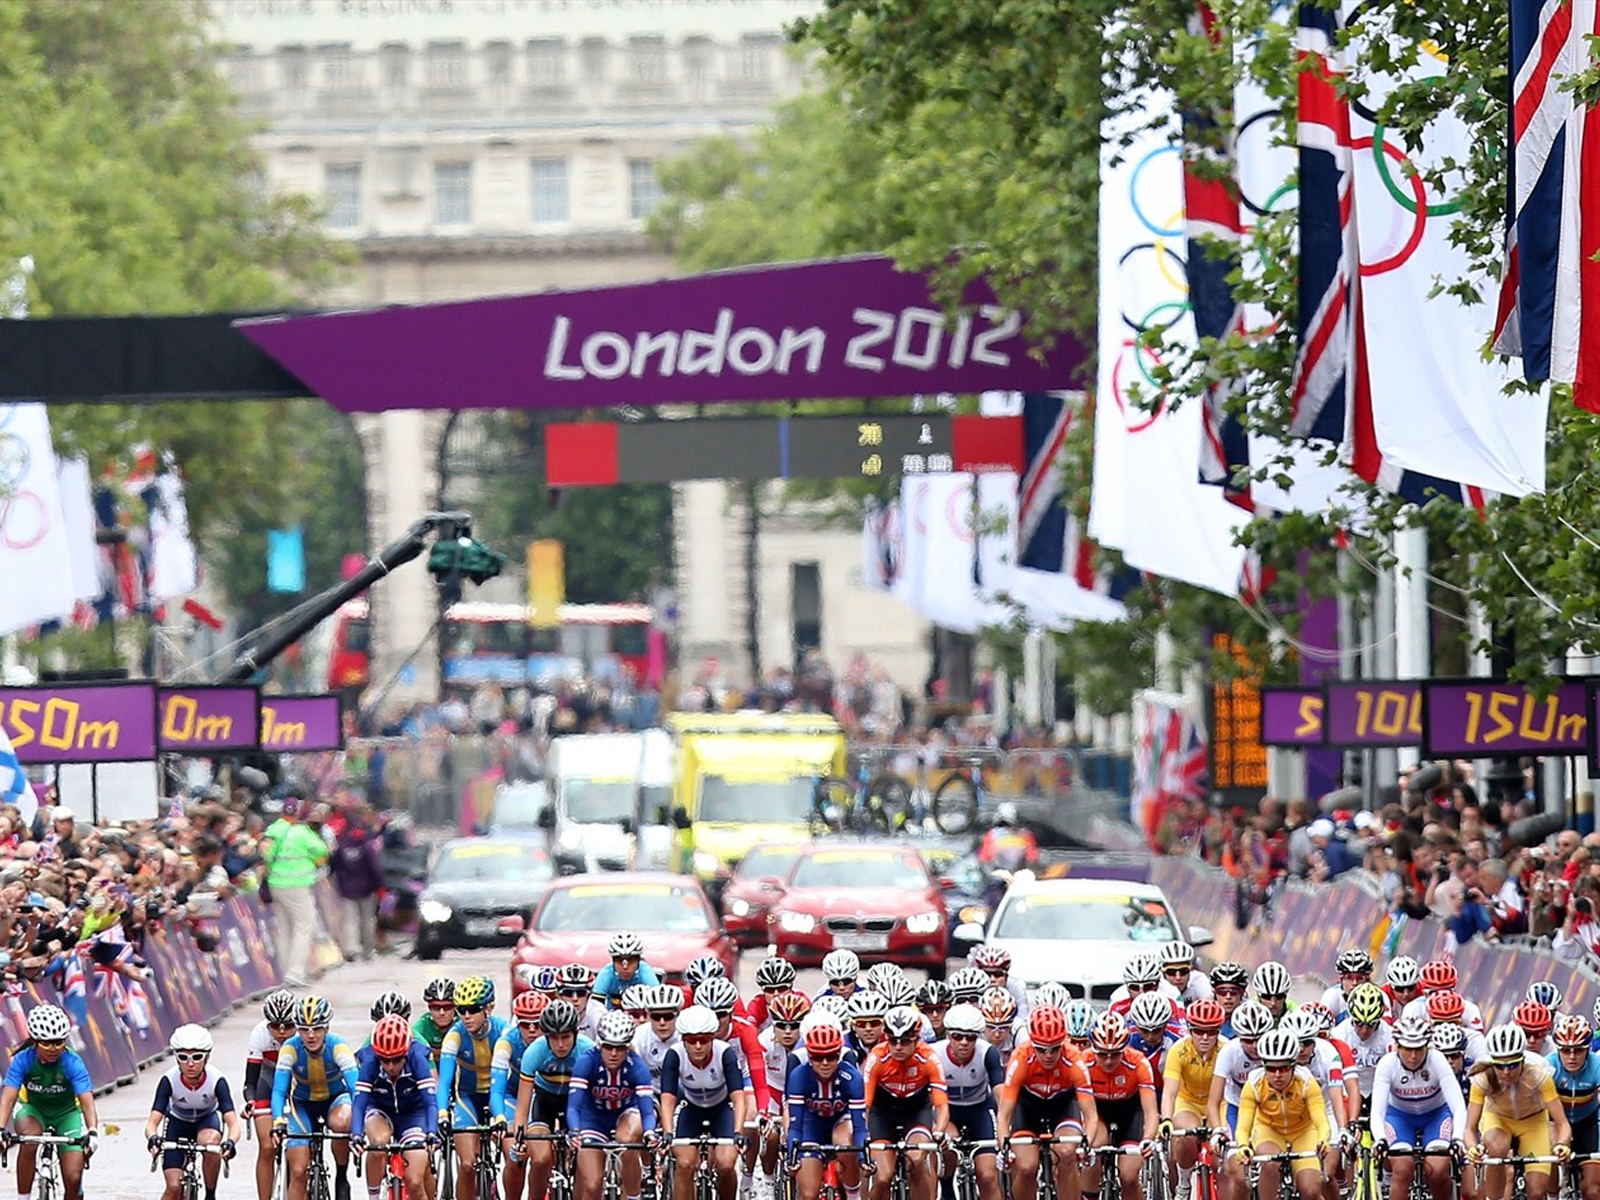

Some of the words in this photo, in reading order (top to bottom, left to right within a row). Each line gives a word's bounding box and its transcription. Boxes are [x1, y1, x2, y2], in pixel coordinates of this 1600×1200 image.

[543, 306, 827, 380] London
[845, 304, 1022, 373] 2012
[0, 696, 120, 751] 50m
[806, 1098, 848, 1112] USA
